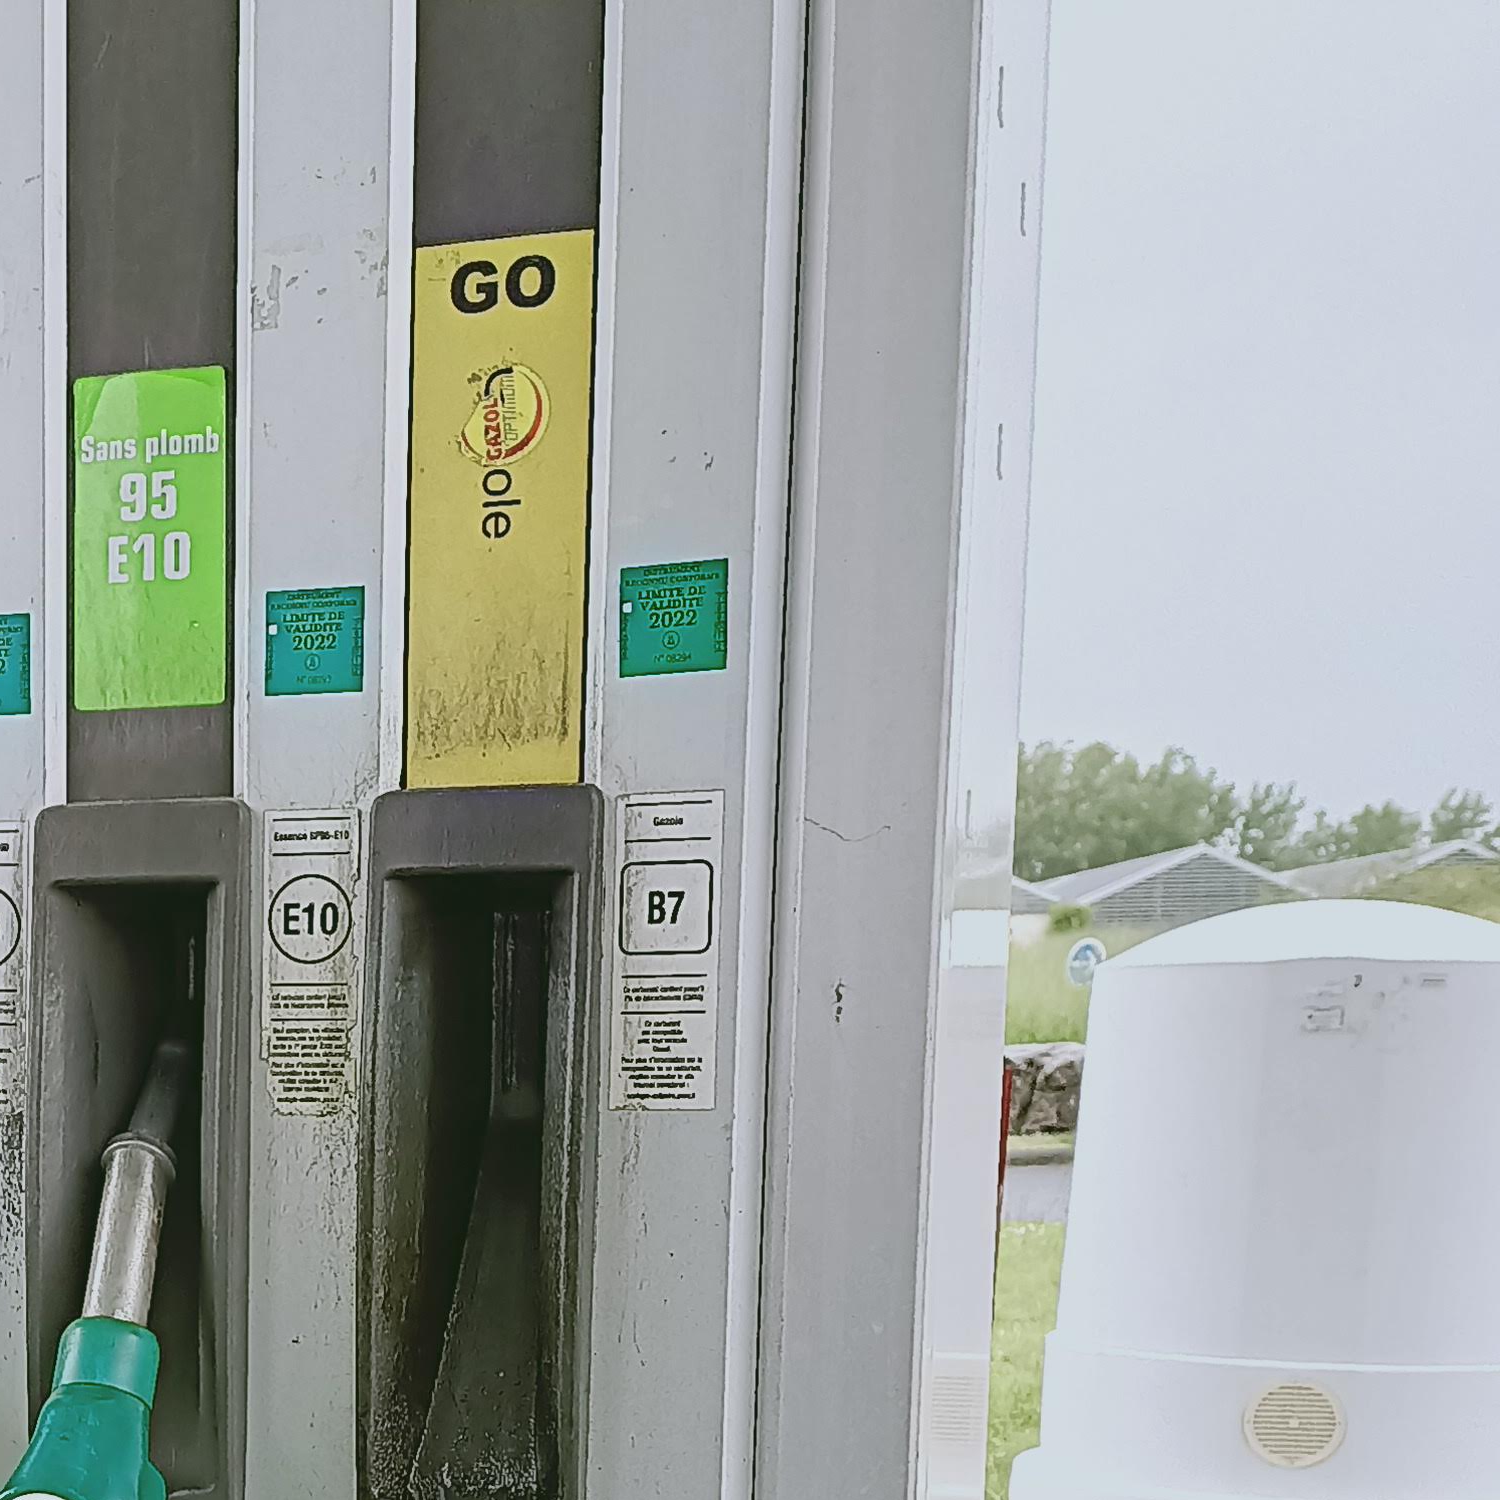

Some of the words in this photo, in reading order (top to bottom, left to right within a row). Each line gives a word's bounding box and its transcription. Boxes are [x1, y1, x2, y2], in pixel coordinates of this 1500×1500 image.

[450, 254, 556, 314] GO
[81, 435, 137, 463] Sans
[145, 425, 219, 464] plomb
[119, 470, 177, 521] 95
[107, 531, 191, 584] E10
[688, 585, 707, 596] DE
[328, 611, 345, 620] DE
[649, 609, 698, 629] 2022
[292, 633, 337, 651] 2022
[282, 902, 340, 936] E10
[647, 890, 685, 925] B7
